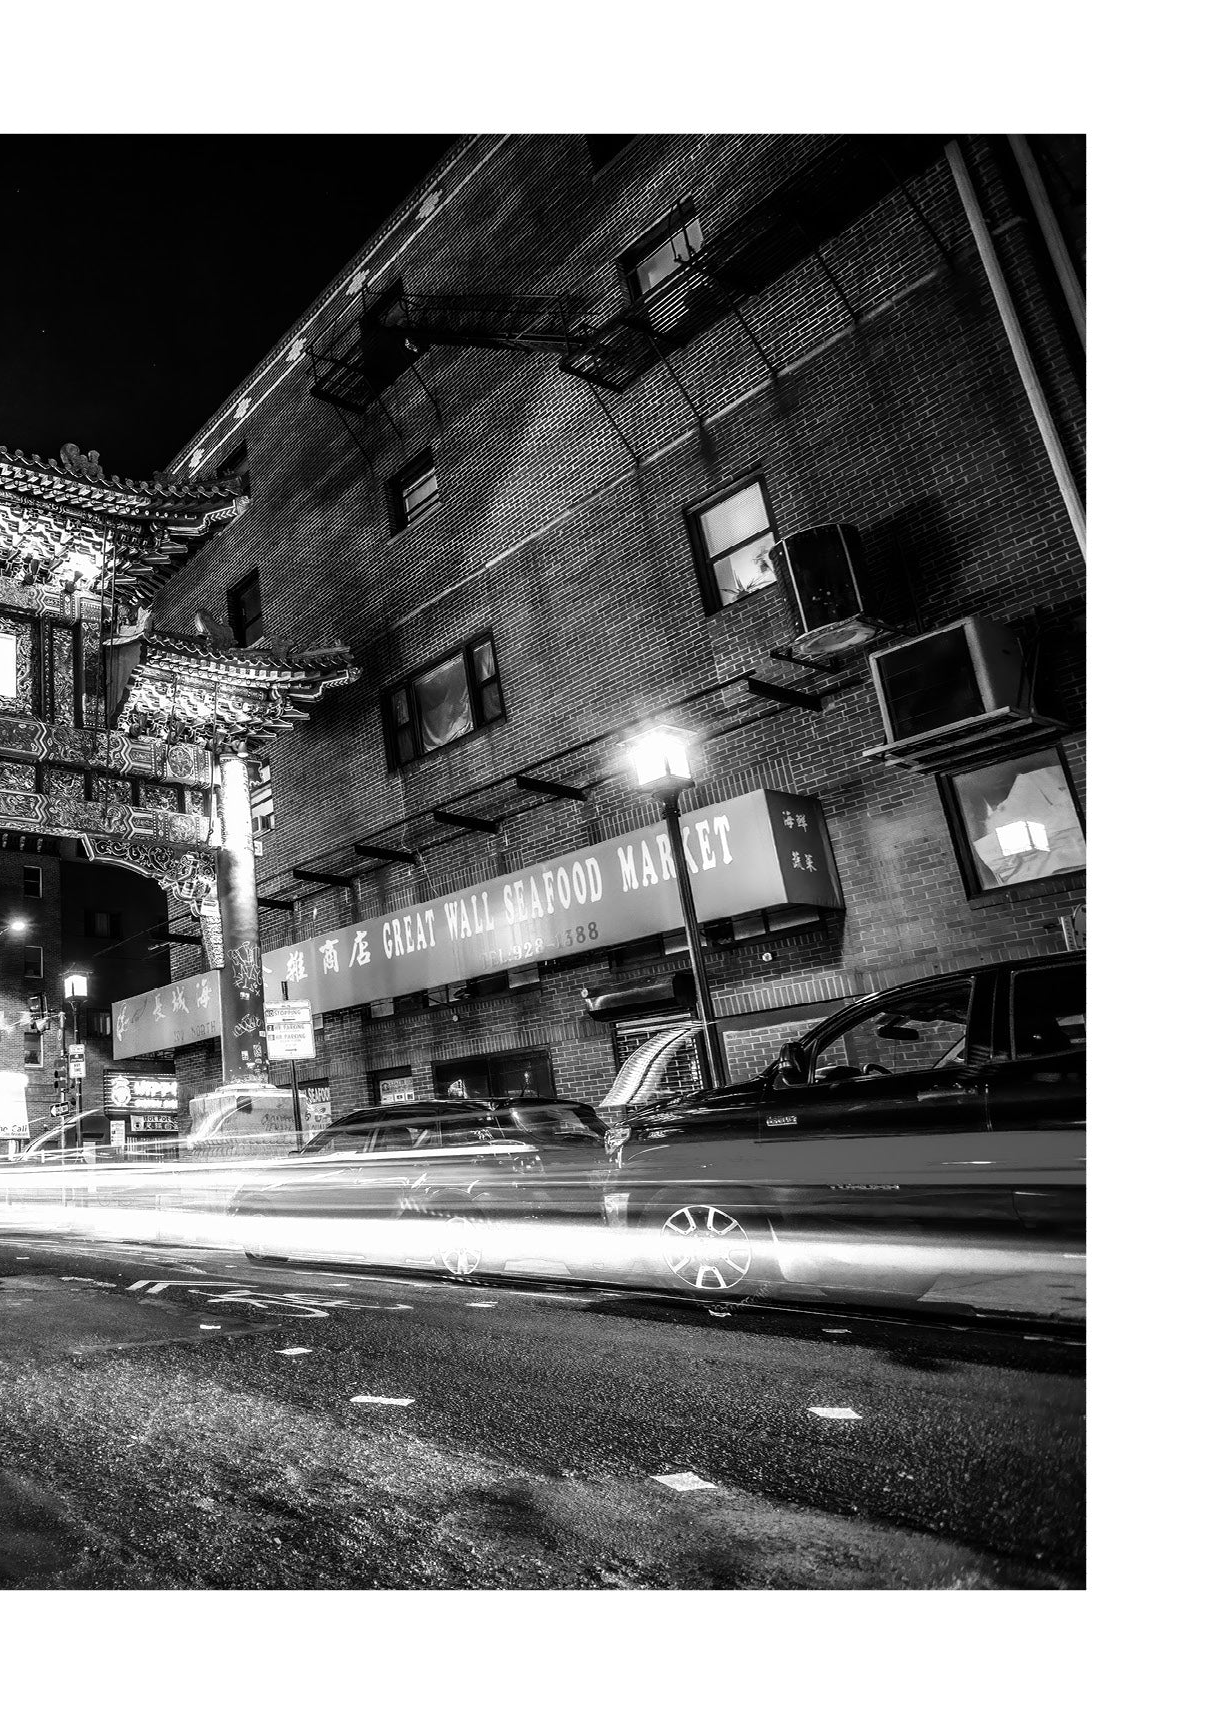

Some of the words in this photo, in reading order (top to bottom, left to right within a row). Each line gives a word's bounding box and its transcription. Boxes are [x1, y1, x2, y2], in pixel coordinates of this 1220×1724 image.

[382, 909, 436, 960] GREAT
[443, 891, 495, 941] WALL
[502, 857, 603, 925] SEAFOOD
[617, 814, 733, 893] MARKET
